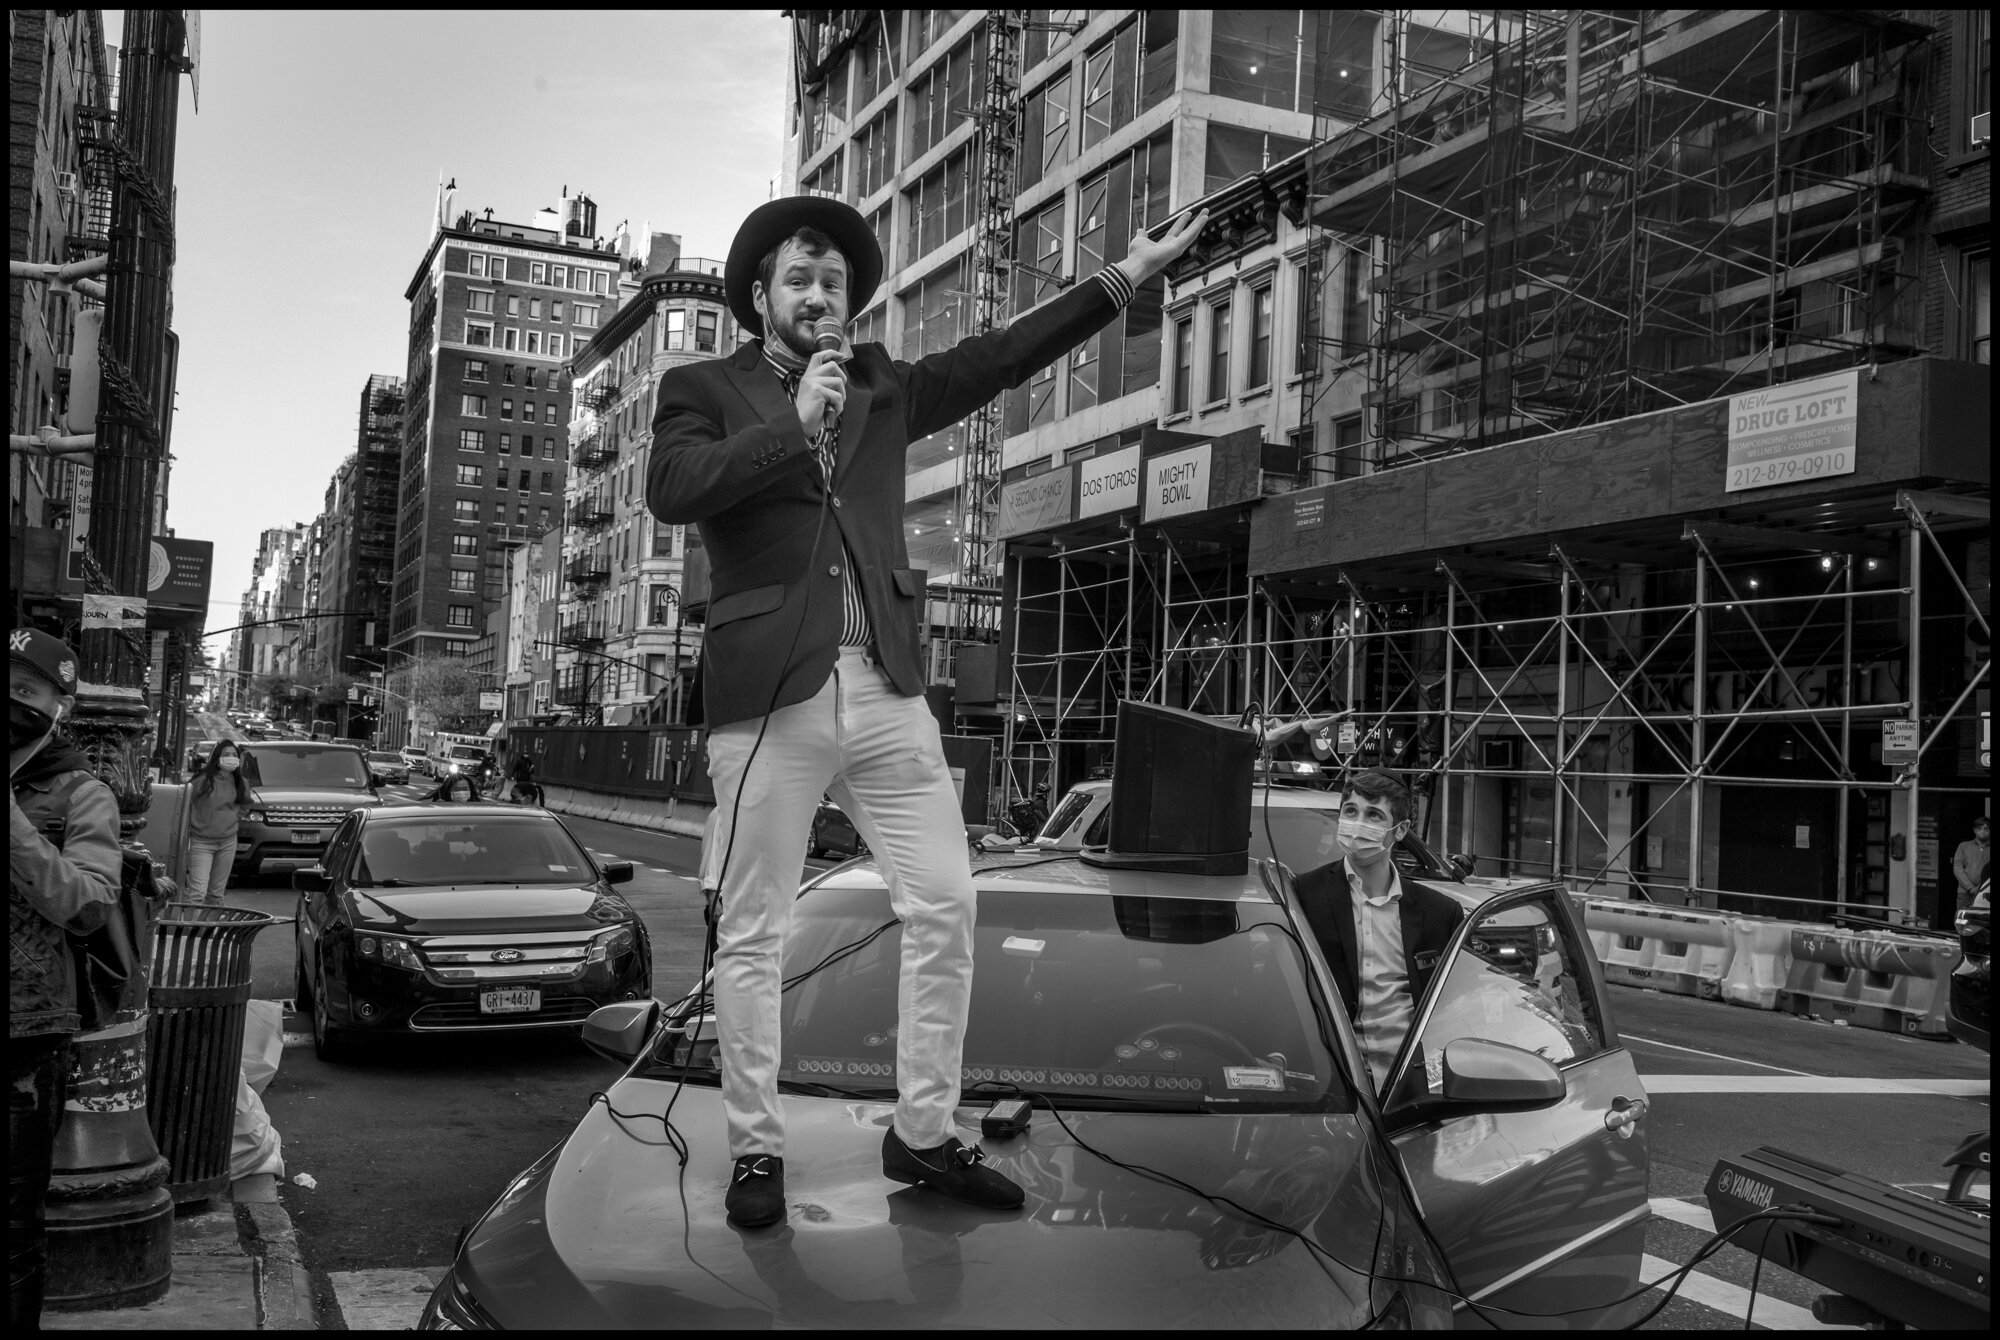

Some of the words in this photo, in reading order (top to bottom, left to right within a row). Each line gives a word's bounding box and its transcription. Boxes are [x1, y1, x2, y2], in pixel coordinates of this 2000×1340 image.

[1736, 408, 1789, 433] DRUG
[1795, 396, 1847, 422] LOFT
[1738, 394, 1769, 411] NEW
[1731, 435, 1787, 452] COMPOUNDING
[1794, 423, 1851, 440] PRESCRIPTIONS
[1747, 446, 1782, 458] WELLNESS
[1788, 437, 1831, 451] COSMETICS
[1083, 478, 1101, 497] DOS
[1104, 467, 1137, 491] TOROS
[1159, 461, 1198, 486] MIGHTY
[1734, 453, 1845, 486] 212-879-0910
[78, 495, 90, 504] Sat
[1015, 488, 1038, 507] SECOND
[1038, 480, 1062, 500] CHANCE
[1163, 485, 1191, 504] BOWL
[1794, 669, 1887, 707] GRLL
[1884, 722, 1894, 733] NO
[499, 951, 518, 960] Ford
[1730, 1173, 1775, 1208] YAMAHA
